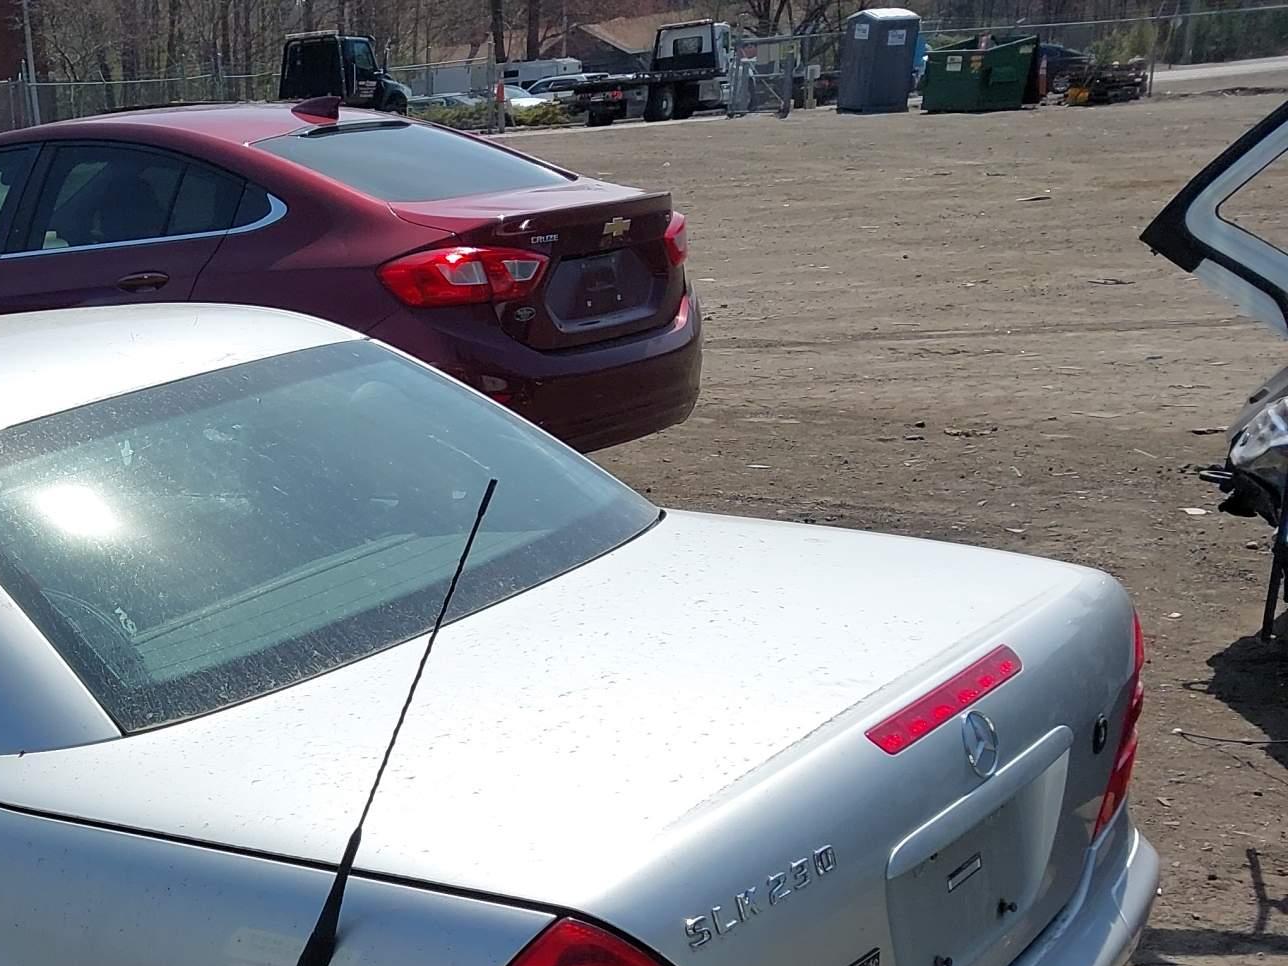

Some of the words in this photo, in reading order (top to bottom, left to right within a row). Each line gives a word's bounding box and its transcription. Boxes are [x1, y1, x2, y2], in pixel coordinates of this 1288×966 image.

[530, 233, 559, 244] CRUZE
[684, 885, 762, 949] SLK
[766, 843, 837, 906] 230
